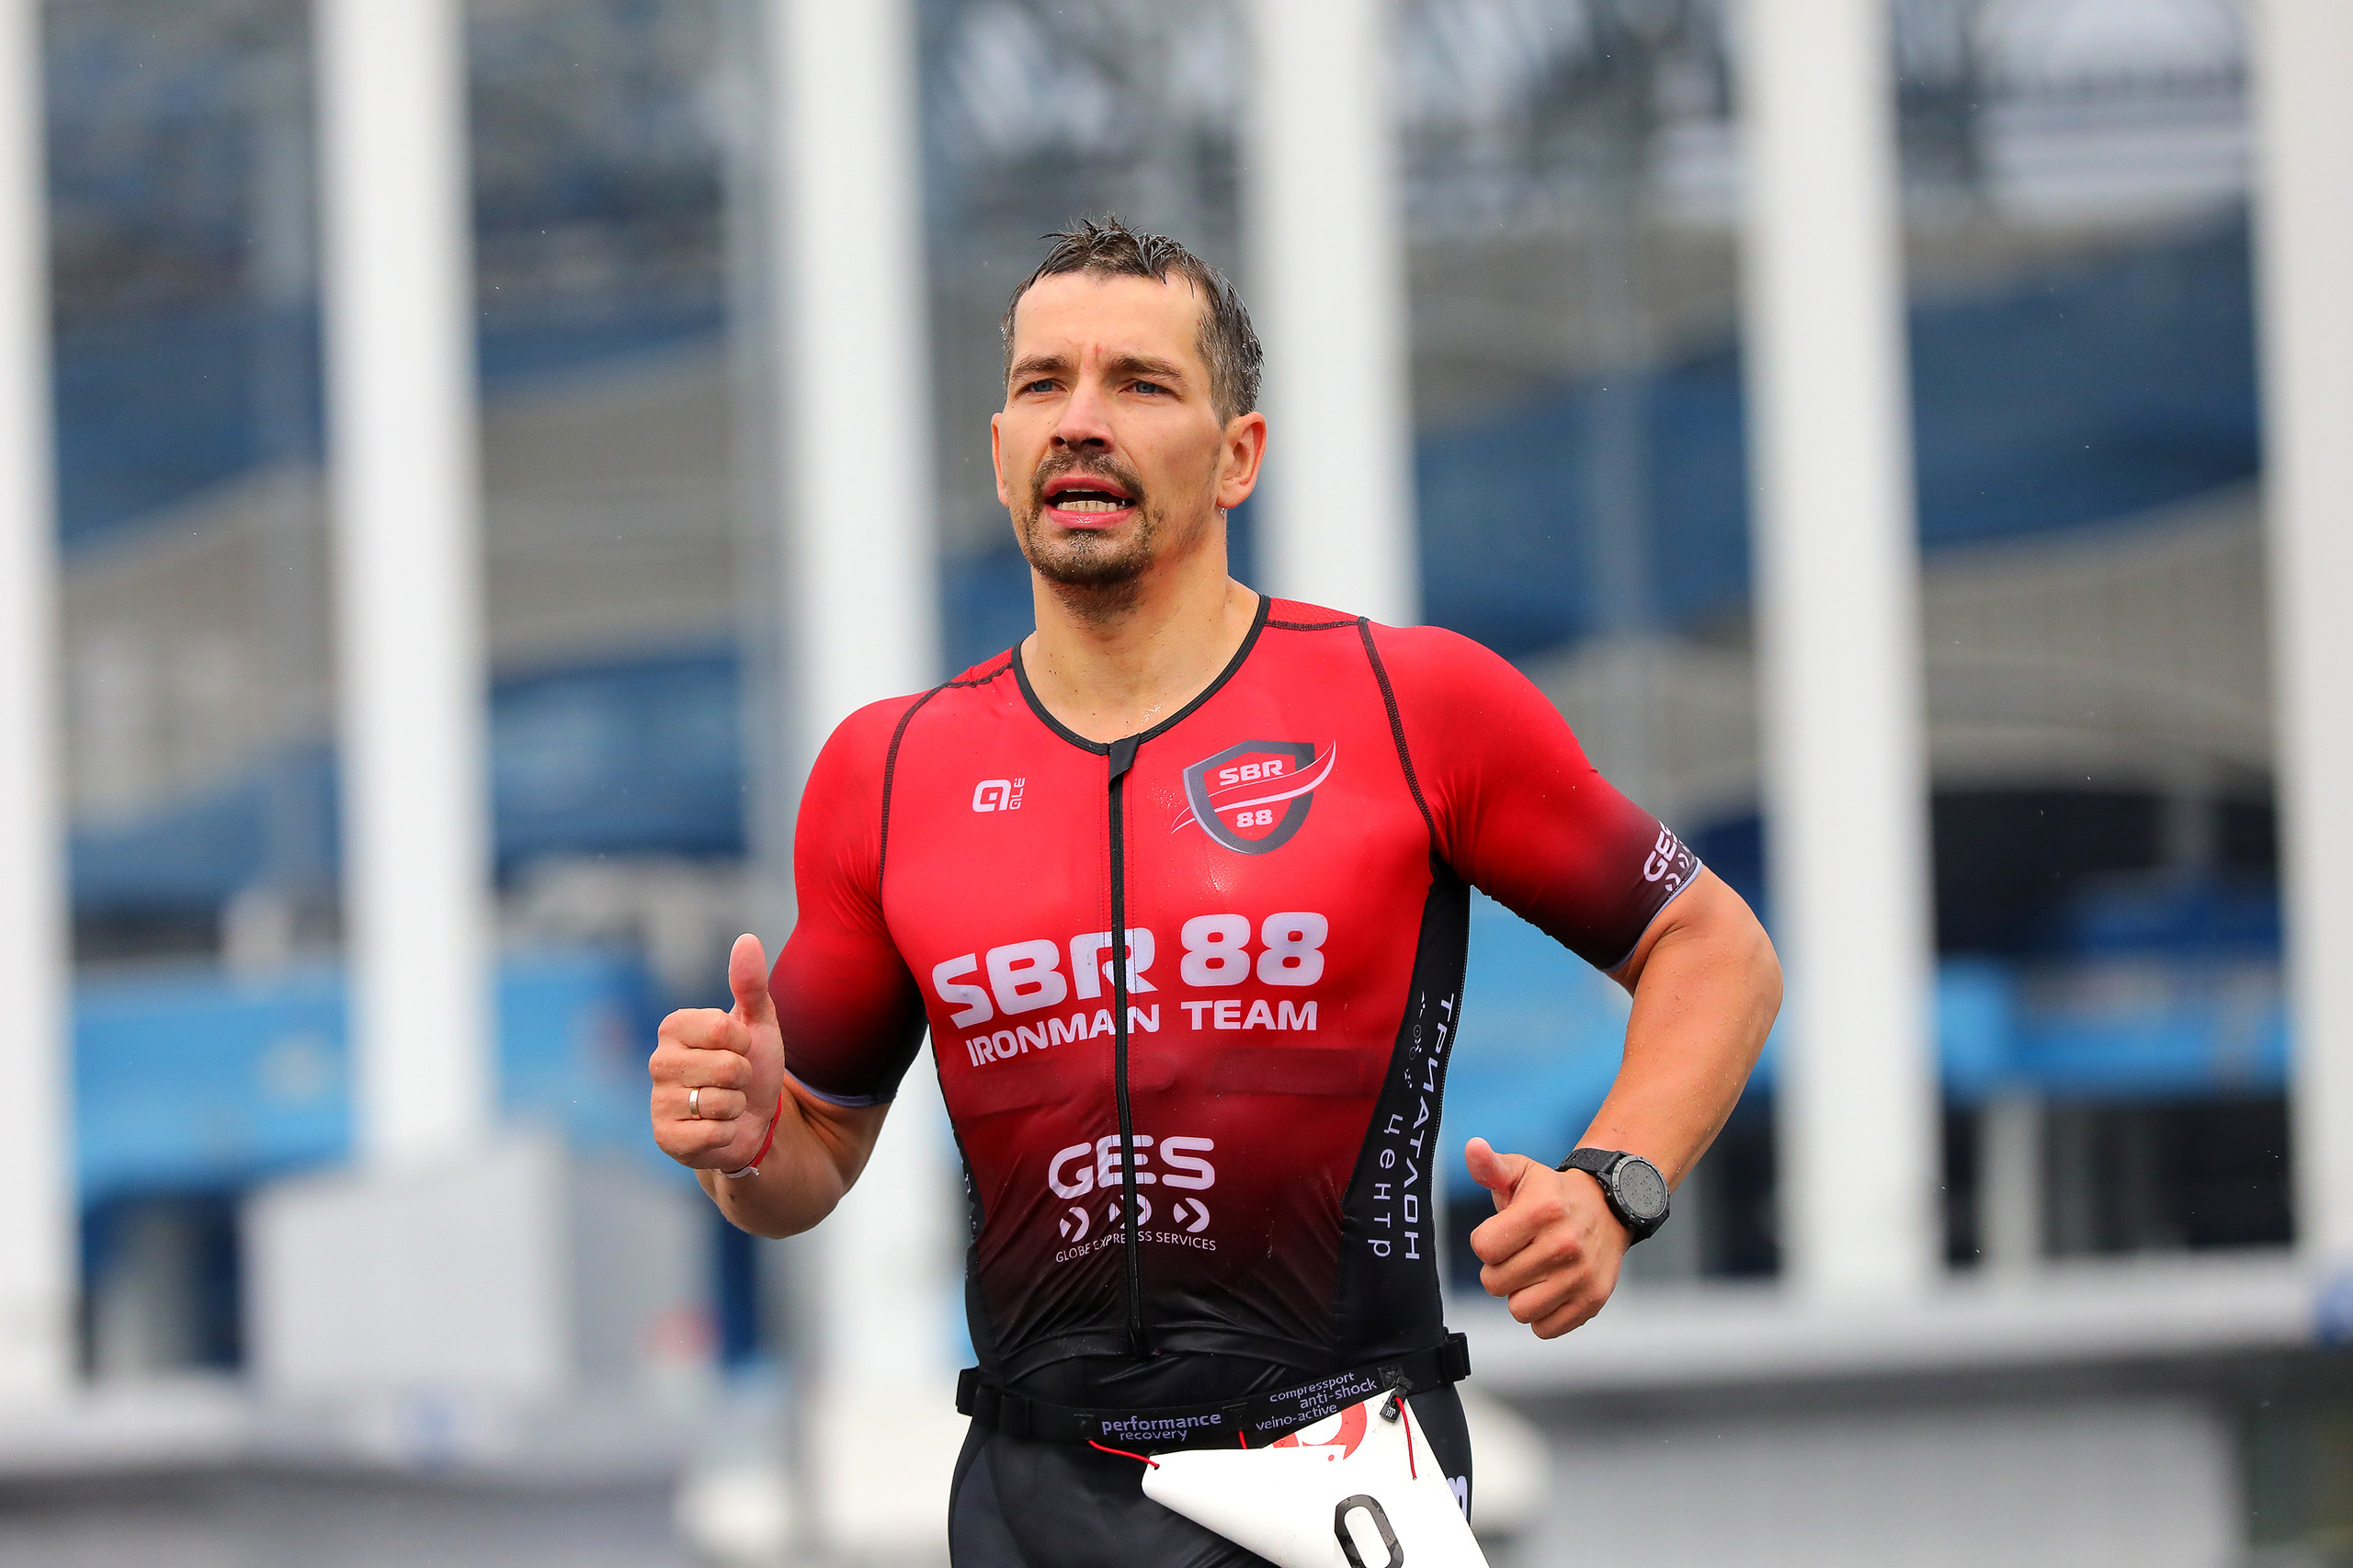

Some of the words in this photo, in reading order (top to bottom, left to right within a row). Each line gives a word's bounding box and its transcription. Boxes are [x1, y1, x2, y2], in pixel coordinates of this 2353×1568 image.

[1219, 759, 1284, 786] SBR
[1236, 809, 1273, 828] 88
[932, 926, 1159, 1028] SBR
[1180, 912, 1329, 986] 88
[965, 1004, 1160, 1067] IRONMAN
[1181, 1000, 1318, 1030] TEAM
[1049, 1134, 1215, 1199] GES
[1055, 1242, 1091, 1263] GLOBE
[1093, 1231, 1154, 1251] EXPRESS
[1155, 1232, 1217, 1252] SERVICES
[1269, 1372, 1355, 1403] compressport
[1300, 1378, 1378, 1409] anti-shock
[1101, 1414, 1222, 1436] performance
[1256, 1404, 1337, 1431] veino-active
[1120, 1430, 1188, 1441] recovery
